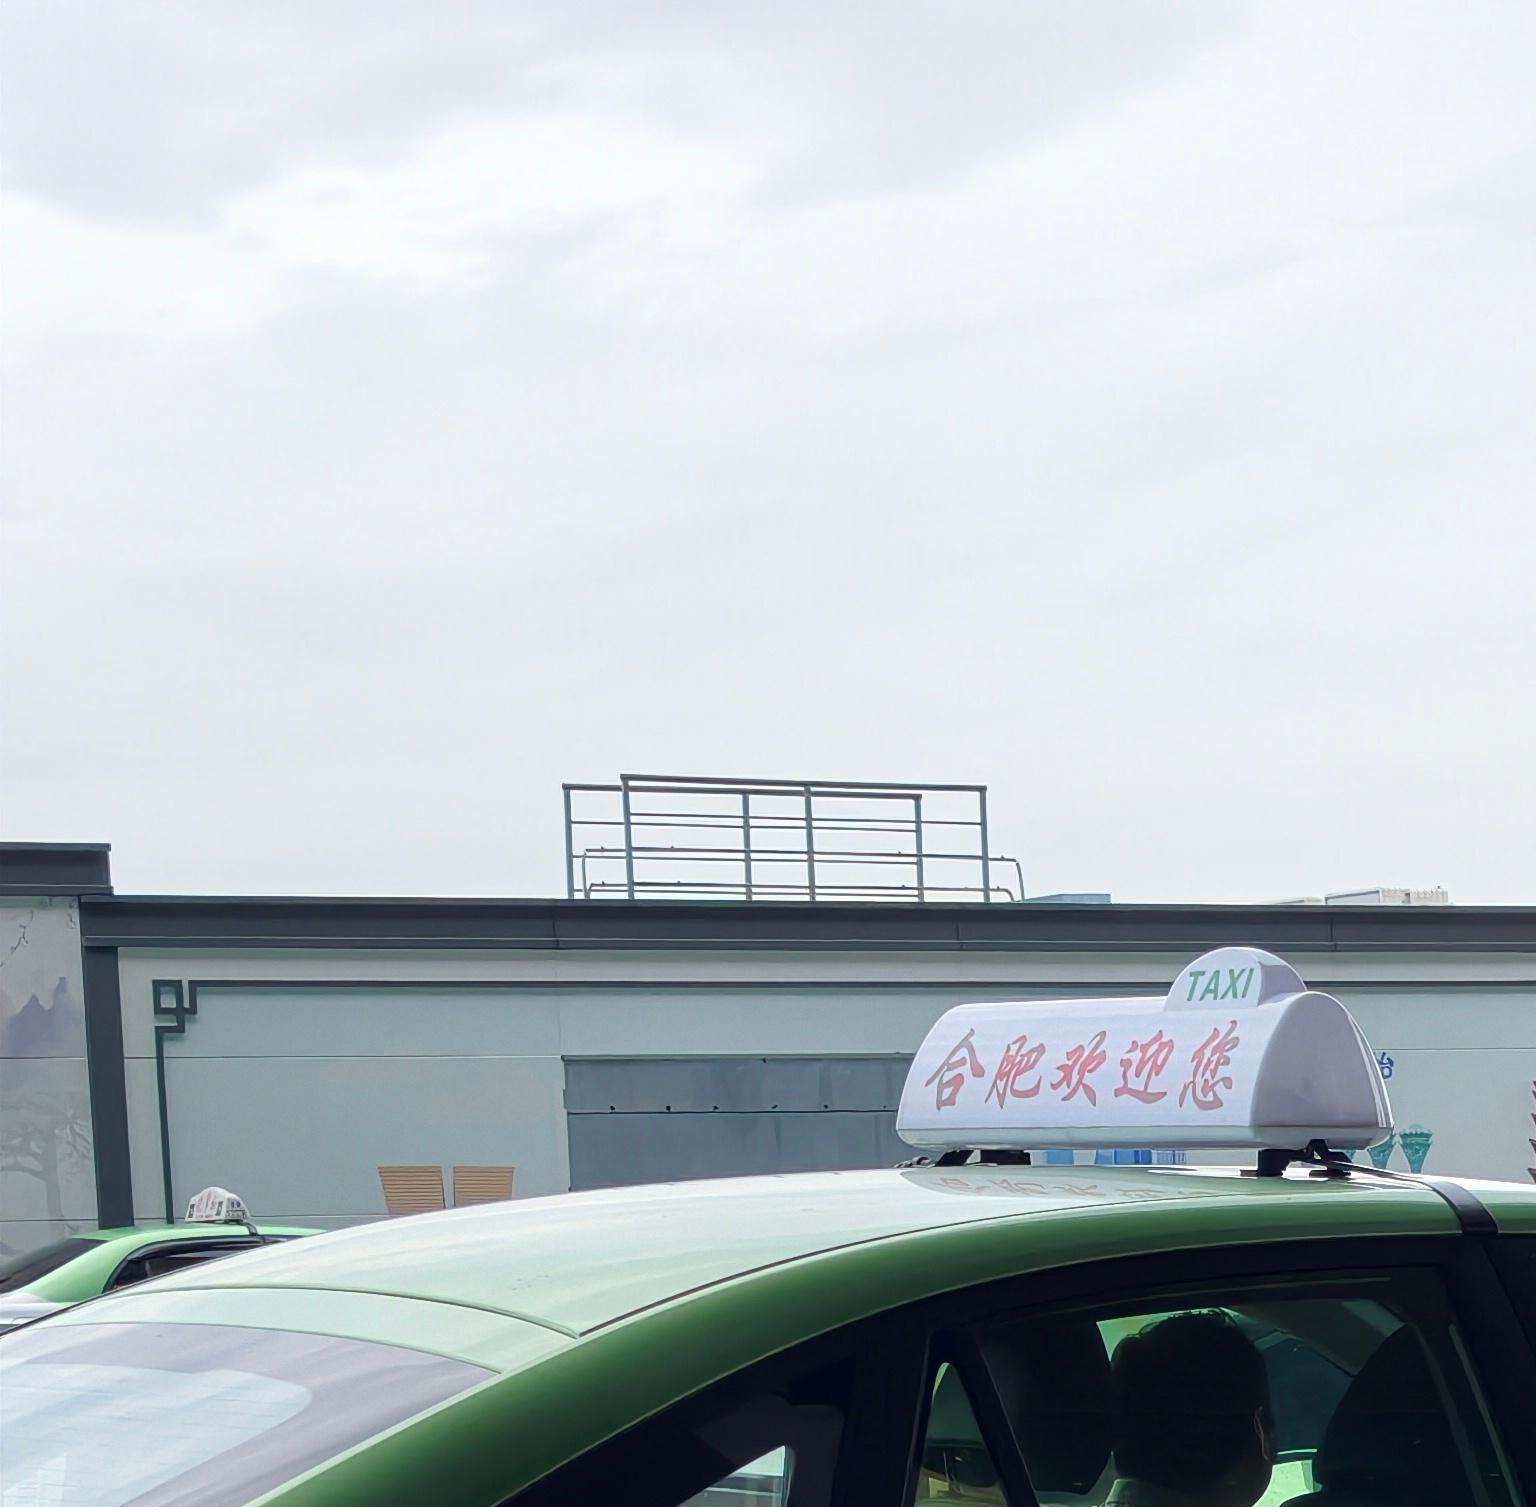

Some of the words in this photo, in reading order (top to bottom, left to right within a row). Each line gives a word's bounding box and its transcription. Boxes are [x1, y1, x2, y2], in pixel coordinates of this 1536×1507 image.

[1186, 967, 1255, 1002] TAXI
[924, 1019, 1241, 1111] 合肥欢迎您
